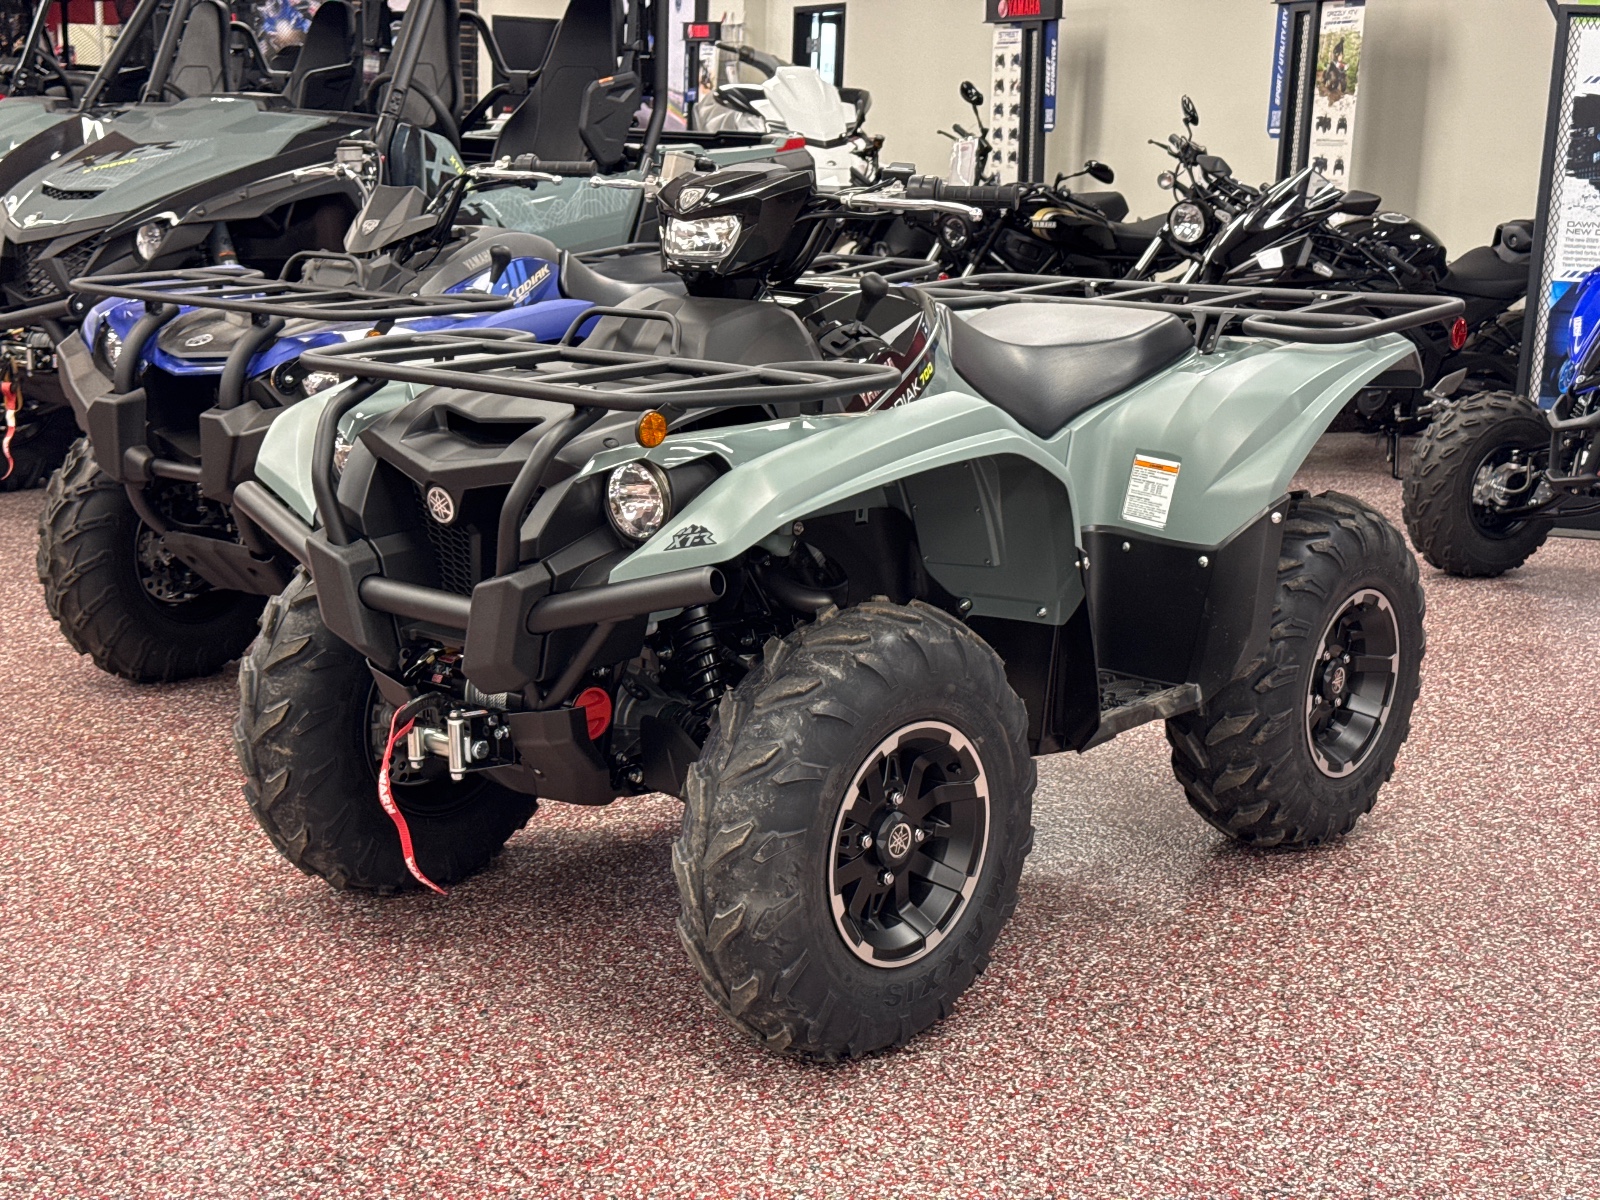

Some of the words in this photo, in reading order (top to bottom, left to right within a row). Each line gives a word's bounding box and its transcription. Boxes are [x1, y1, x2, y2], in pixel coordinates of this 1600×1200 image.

[1007, 0, 1041, 15] YAMAHA
[1278, 28, 1287, 66] UTILITY
[1275, 74, 1283, 105] SPORT
[1032, 221, 1057, 229] YAMAHA
[462, 248, 491, 271] YAMAH
[507, 263, 550, 300] KODIAK
[919, 361, 934, 386] 700
[666, 532, 715, 550] XT-R
[378, 768, 397, 816] WARN
[883, 855, 1007, 1007] MAXXIS
